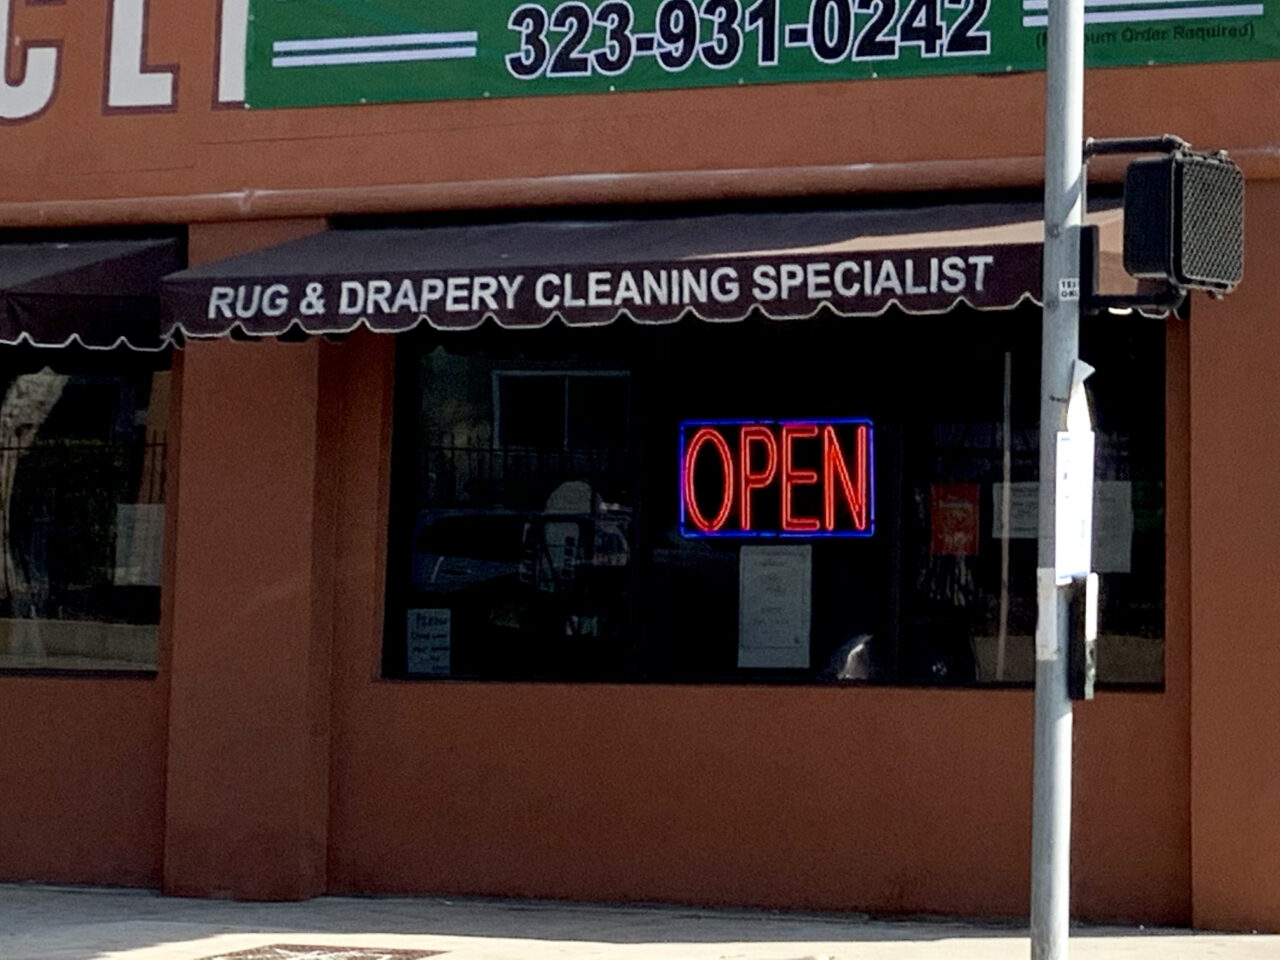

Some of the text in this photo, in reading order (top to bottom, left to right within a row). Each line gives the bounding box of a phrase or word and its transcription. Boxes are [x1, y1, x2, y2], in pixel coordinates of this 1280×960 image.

[208, 255, 994, 320] RUG & DRAPERY CLEANING SPECIALIST
[685, 426, 866, 532] OPEN
